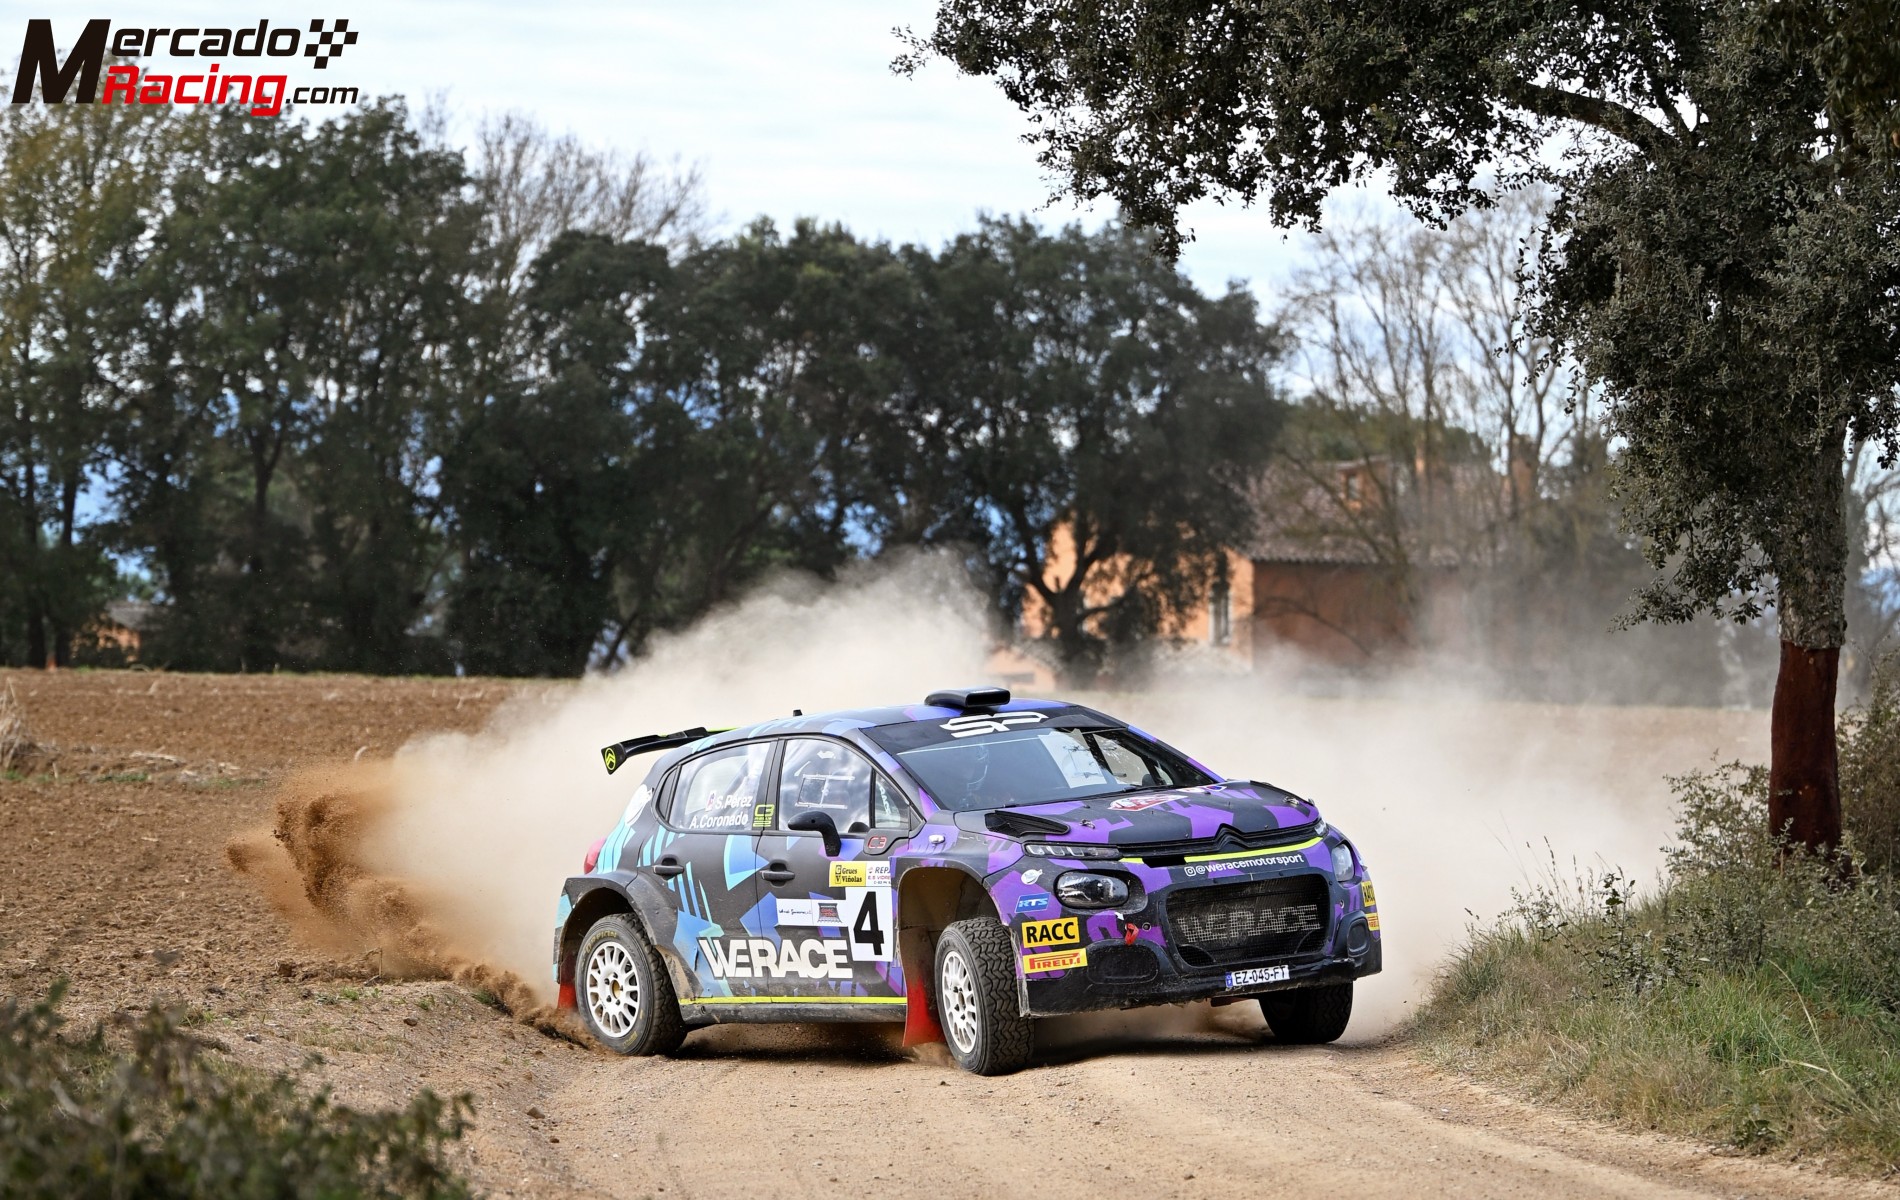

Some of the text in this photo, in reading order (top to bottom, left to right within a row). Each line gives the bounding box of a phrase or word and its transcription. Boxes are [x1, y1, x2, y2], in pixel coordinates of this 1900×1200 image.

[689, 811, 749, 830] A.Coronado
[868, 836, 887, 849] C3
[842, 867, 857, 875] Grues
[1196, 854, 1305, 875] @weracemotorsport
[842, 875, 862, 883] Viñolas
[1018, 897, 1049, 909] RTS
[853, 891, 885, 956] 4
[1026, 921, 1076, 944] RACC
[1177, 904, 1321, 943] WERACE
[698, 938, 853, 979] WERACE
[1028, 952, 1081, 970] PIRELLI
[1234, 966, 1286, 985] EZ-045-FT
